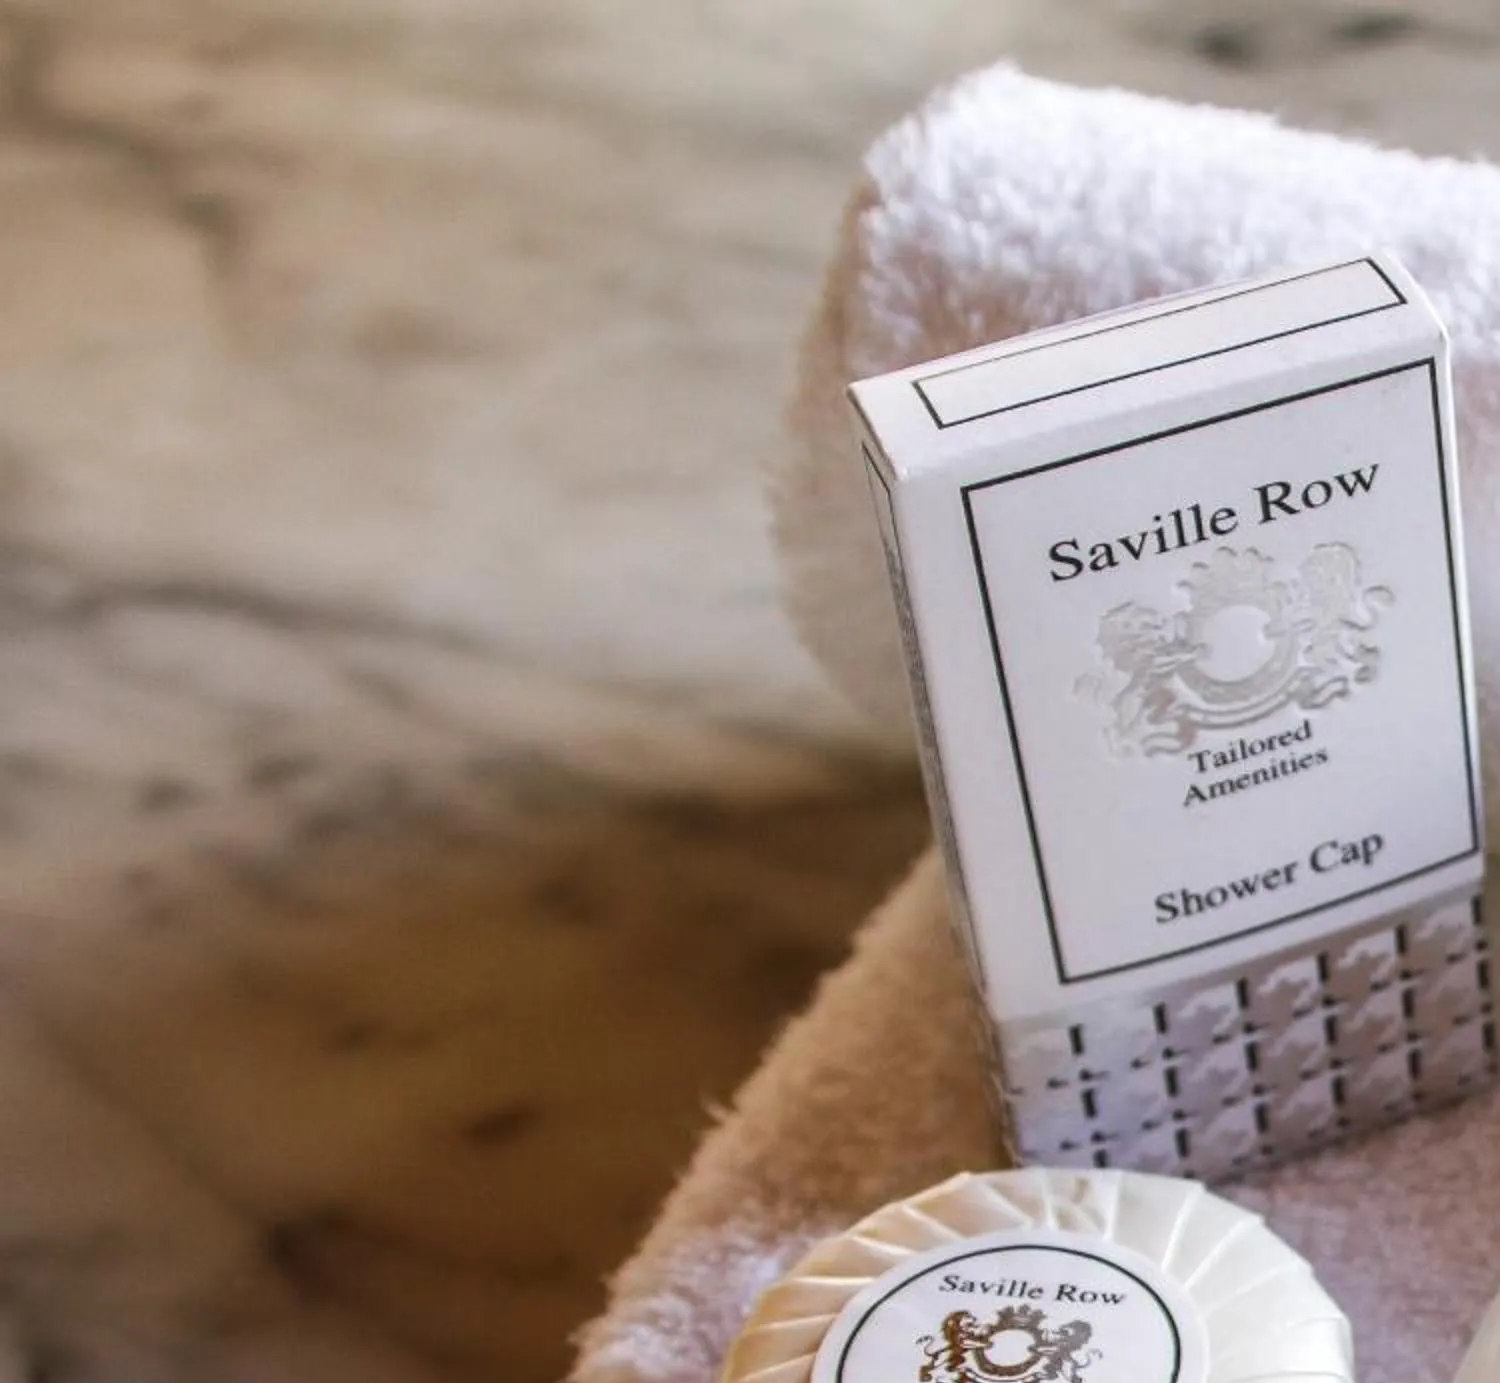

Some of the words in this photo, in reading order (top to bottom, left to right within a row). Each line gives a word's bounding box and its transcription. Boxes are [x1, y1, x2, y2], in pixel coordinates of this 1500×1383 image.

[1049, 503, 1238, 582] Saville
[1253, 463, 1380, 524] Row
[1188, 719, 1313, 774] Tailored
[1182, 747, 1328, 806] Amenities
[1154, 858, 1298, 924] Shower
[1309, 832, 1384, 875] Cap
[938, 1275, 1044, 1300] Saville
[1055, 1284, 1126, 1306] Row
